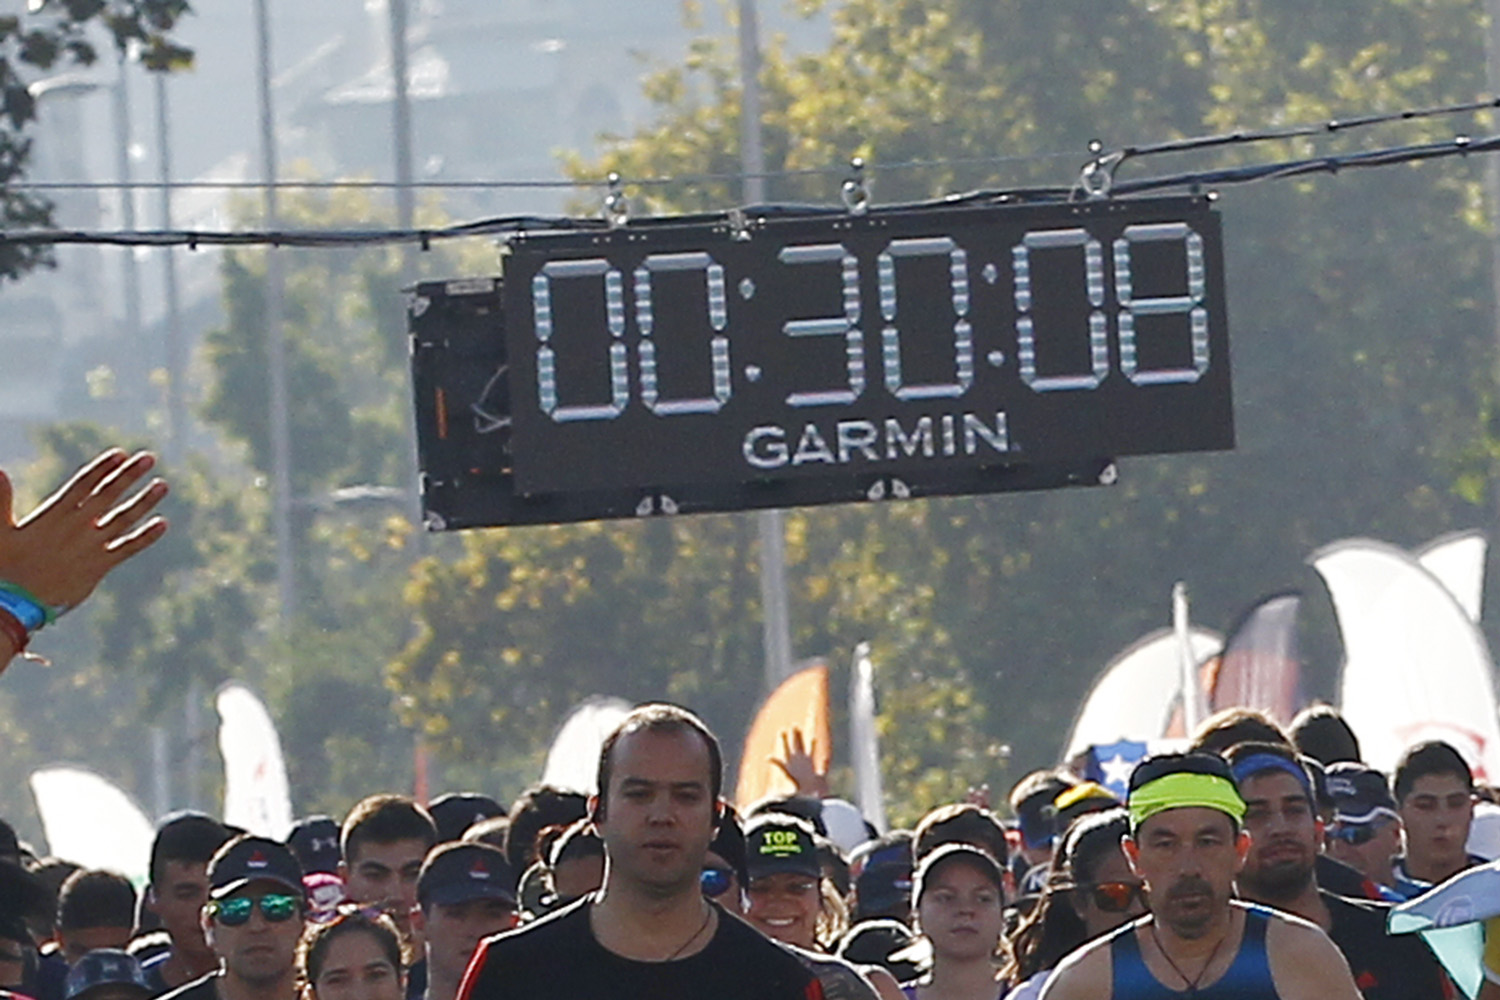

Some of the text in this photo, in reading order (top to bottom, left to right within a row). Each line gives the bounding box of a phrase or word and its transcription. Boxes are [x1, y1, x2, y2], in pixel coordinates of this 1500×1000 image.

[532, 221, 1211, 422] 00:30:08
[742, 411, 1010, 469] GARMIN
[763, 831, 798, 845] TOP
